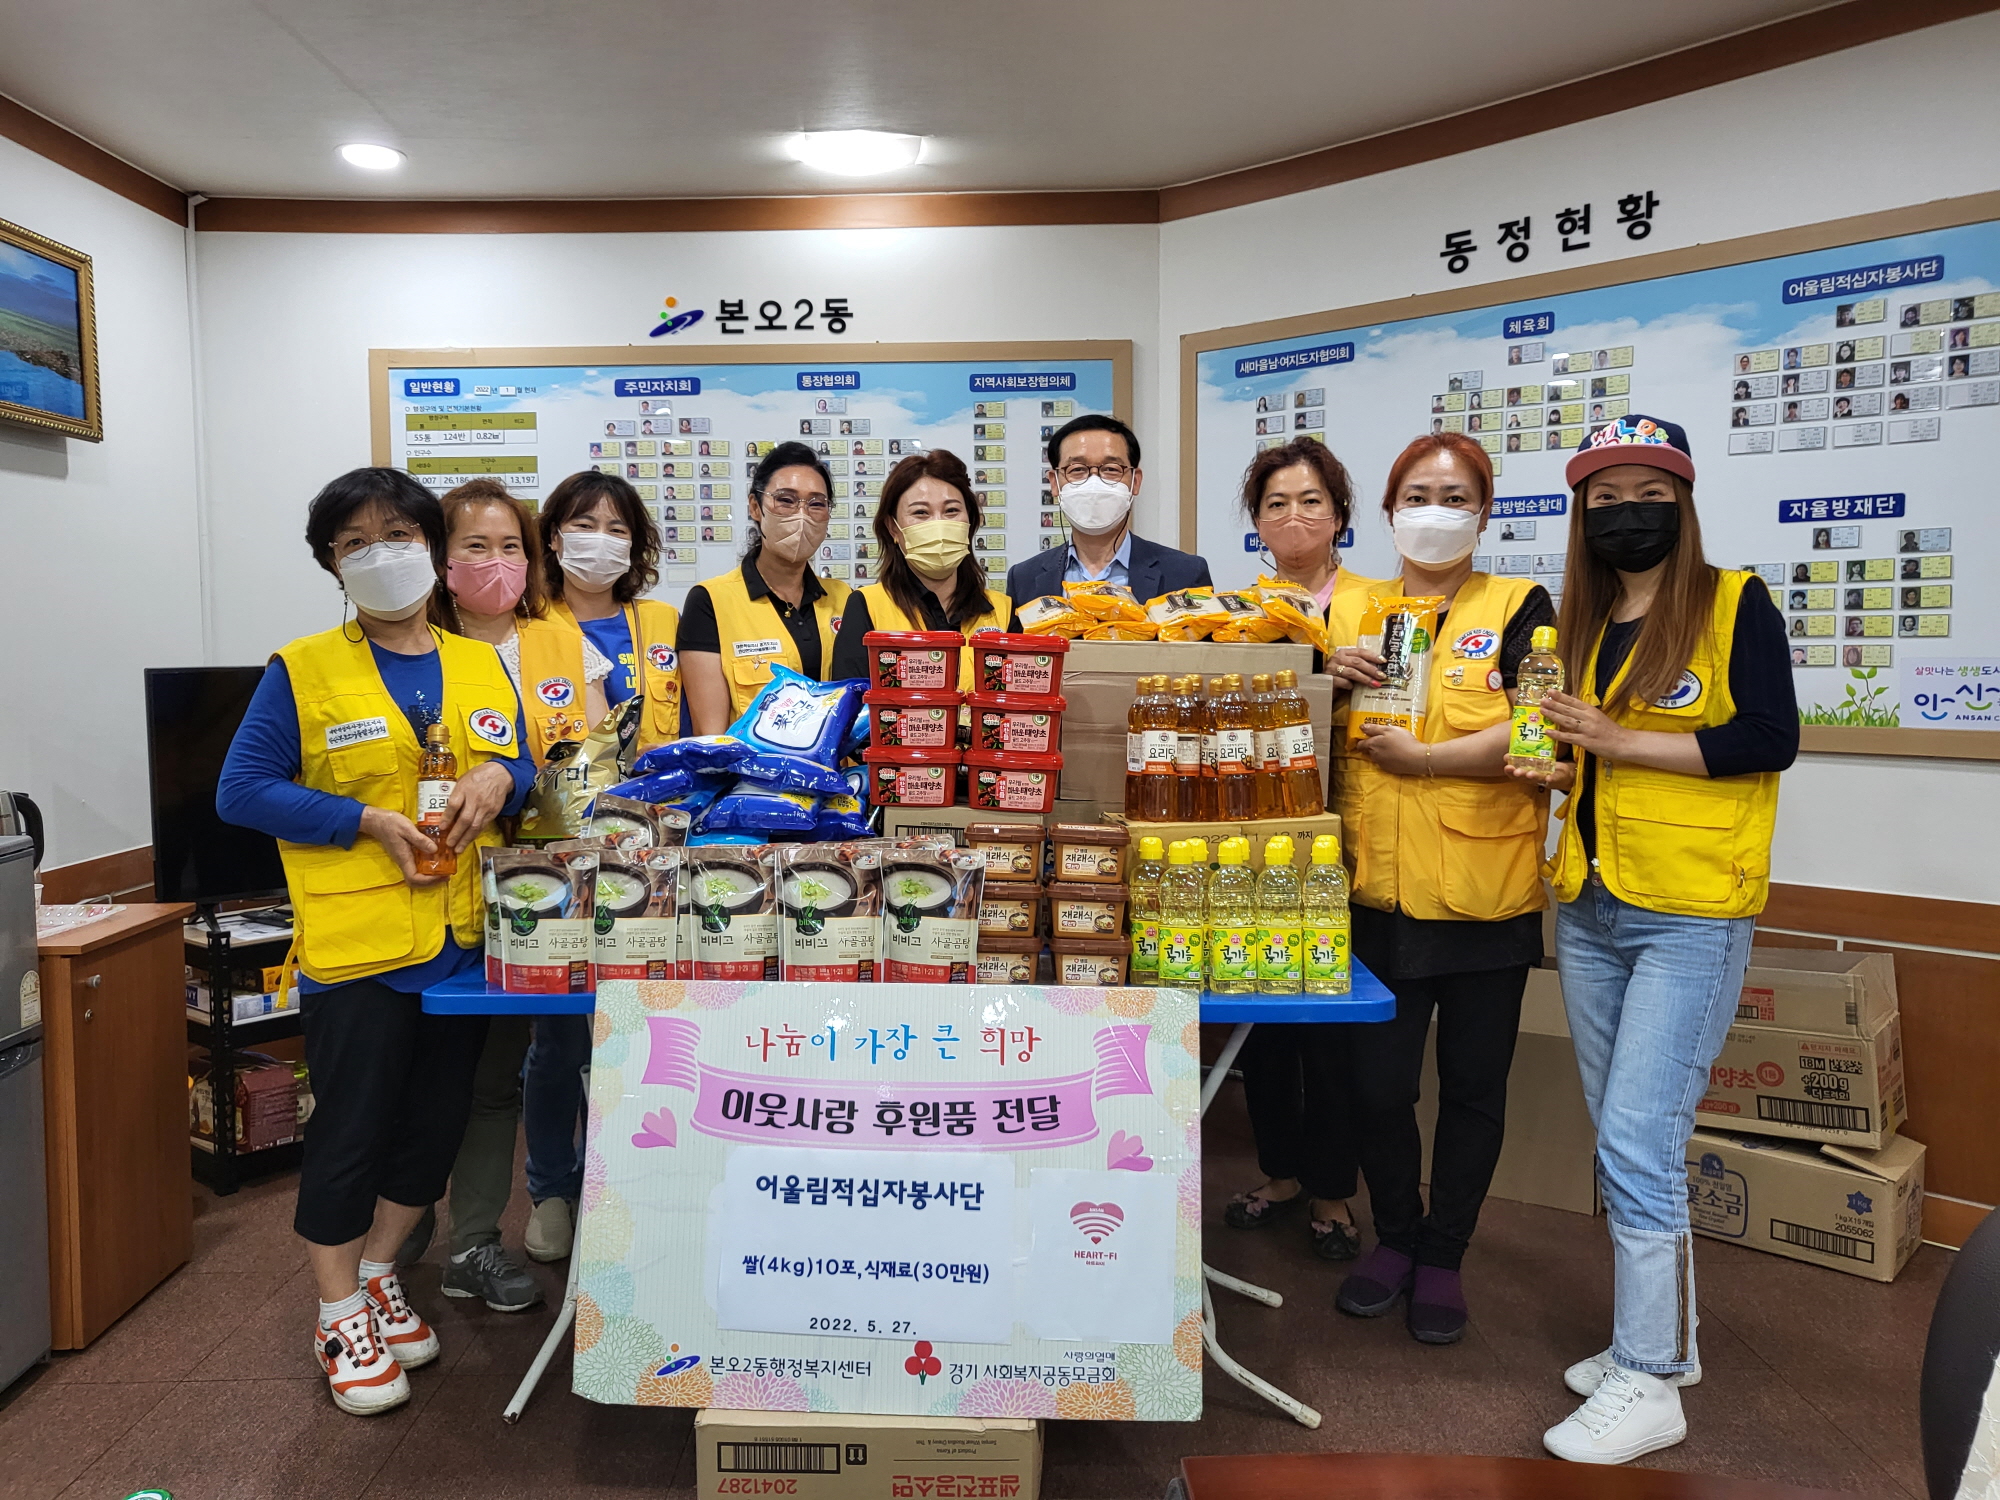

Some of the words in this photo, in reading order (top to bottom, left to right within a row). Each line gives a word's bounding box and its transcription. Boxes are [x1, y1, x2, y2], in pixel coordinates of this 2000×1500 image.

[1440, 190, 1660, 274] 동정현황
[1788, 259, 1939, 298] 어울림적십자봉사단
[715, 298, 854, 335] 본오2동
[1508, 315, 1549, 336] 체육회
[409, 381, 455, 394] 일반현황
[623, 379, 692, 394] 주민자치회
[801, 374, 855, 387] 통장협의회
[974, 376, 1071, 389] 지역사회보장협의체
[414, 434, 432, 442] 55통
[443, 432, 466, 442] 124반
[510, 476, 536, 484] 13,197
[1490, 498, 1563, 515] 율방범순찰대
[1788, 496, 1897, 520] 자율방재단
[908, 666, 944, 674] 매운태양초
[1014, 670, 1050, 679] 매운태양초
[1914, 666, 1954, 676] 살맛나는
[908, 723, 944, 732] 매운태양초
[1012, 728, 1047, 738] 매운태양초
[1516, 722, 1547, 742] 콩기름
[1220, 747, 1248, 760] 요리당
[908, 781, 942, 790] 매운태양초
[1008, 786, 1043, 796] 매운태양초
[428, 798, 449, 810] 요리
[1065, 853, 1096, 864] 재래식
[1061, 910, 1093, 921] 재래식
[510, 938, 540, 950] 비비고
[548, 936, 588, 949] 사골곰탕
[626, 936, 668, 948] 사골곰탕
[700, 934, 734, 946] 비비고
[794, 938, 828, 950] 비비고
[838, 934, 875, 948] 사골곰탕
[892, 934, 922, 947] 비비고
[930, 936, 971, 950] 사골곰탕
[1136, 936, 1158, 956] 콩기
[1164, 944, 1194, 964] 콩기름
[1220, 945, 1250, 965] 콩기름
[1262, 945, 1294, 964] 콩기름
[1308, 946, 1340, 964] 콩기름
[977, 961, 1008, 972] 재래식
[1065, 964, 1097, 974] 재래식
[746, 1024, 837, 1064] 나눔이
[854, 1023, 918, 1066] 가장
[931, 1024, 961, 1060] 큰
[979, 1026, 1042, 1066] 희망
[1802, 1058, 1824, 1069] 18M
[720, 1088, 859, 1135] 이웃사랑
[872, 1100, 977, 1137] 후원품
[992, 1094, 1062, 1134] 전달
[756, 1174, 985, 1211] 어울림적십자봉사단
[1834, 1222, 1875, 1239] 2055062
[1074, 1250, 1118, 1261] HEART-FI
[809, 1316, 858, 1333] 2022.
[867, 1320, 883, 1334] 5.
[892, 1320, 918, 1336] 27.
[708, 1354, 872, 1379] 본오2동행정복지센터
[948, 1362, 978, 1386] 경기
[982, 1363, 1118, 1387] 사회복지공동모금회
[718, 1478, 798, 1495] 2041287
[892, 1474, 1020, 1499] 샘표진공소면
